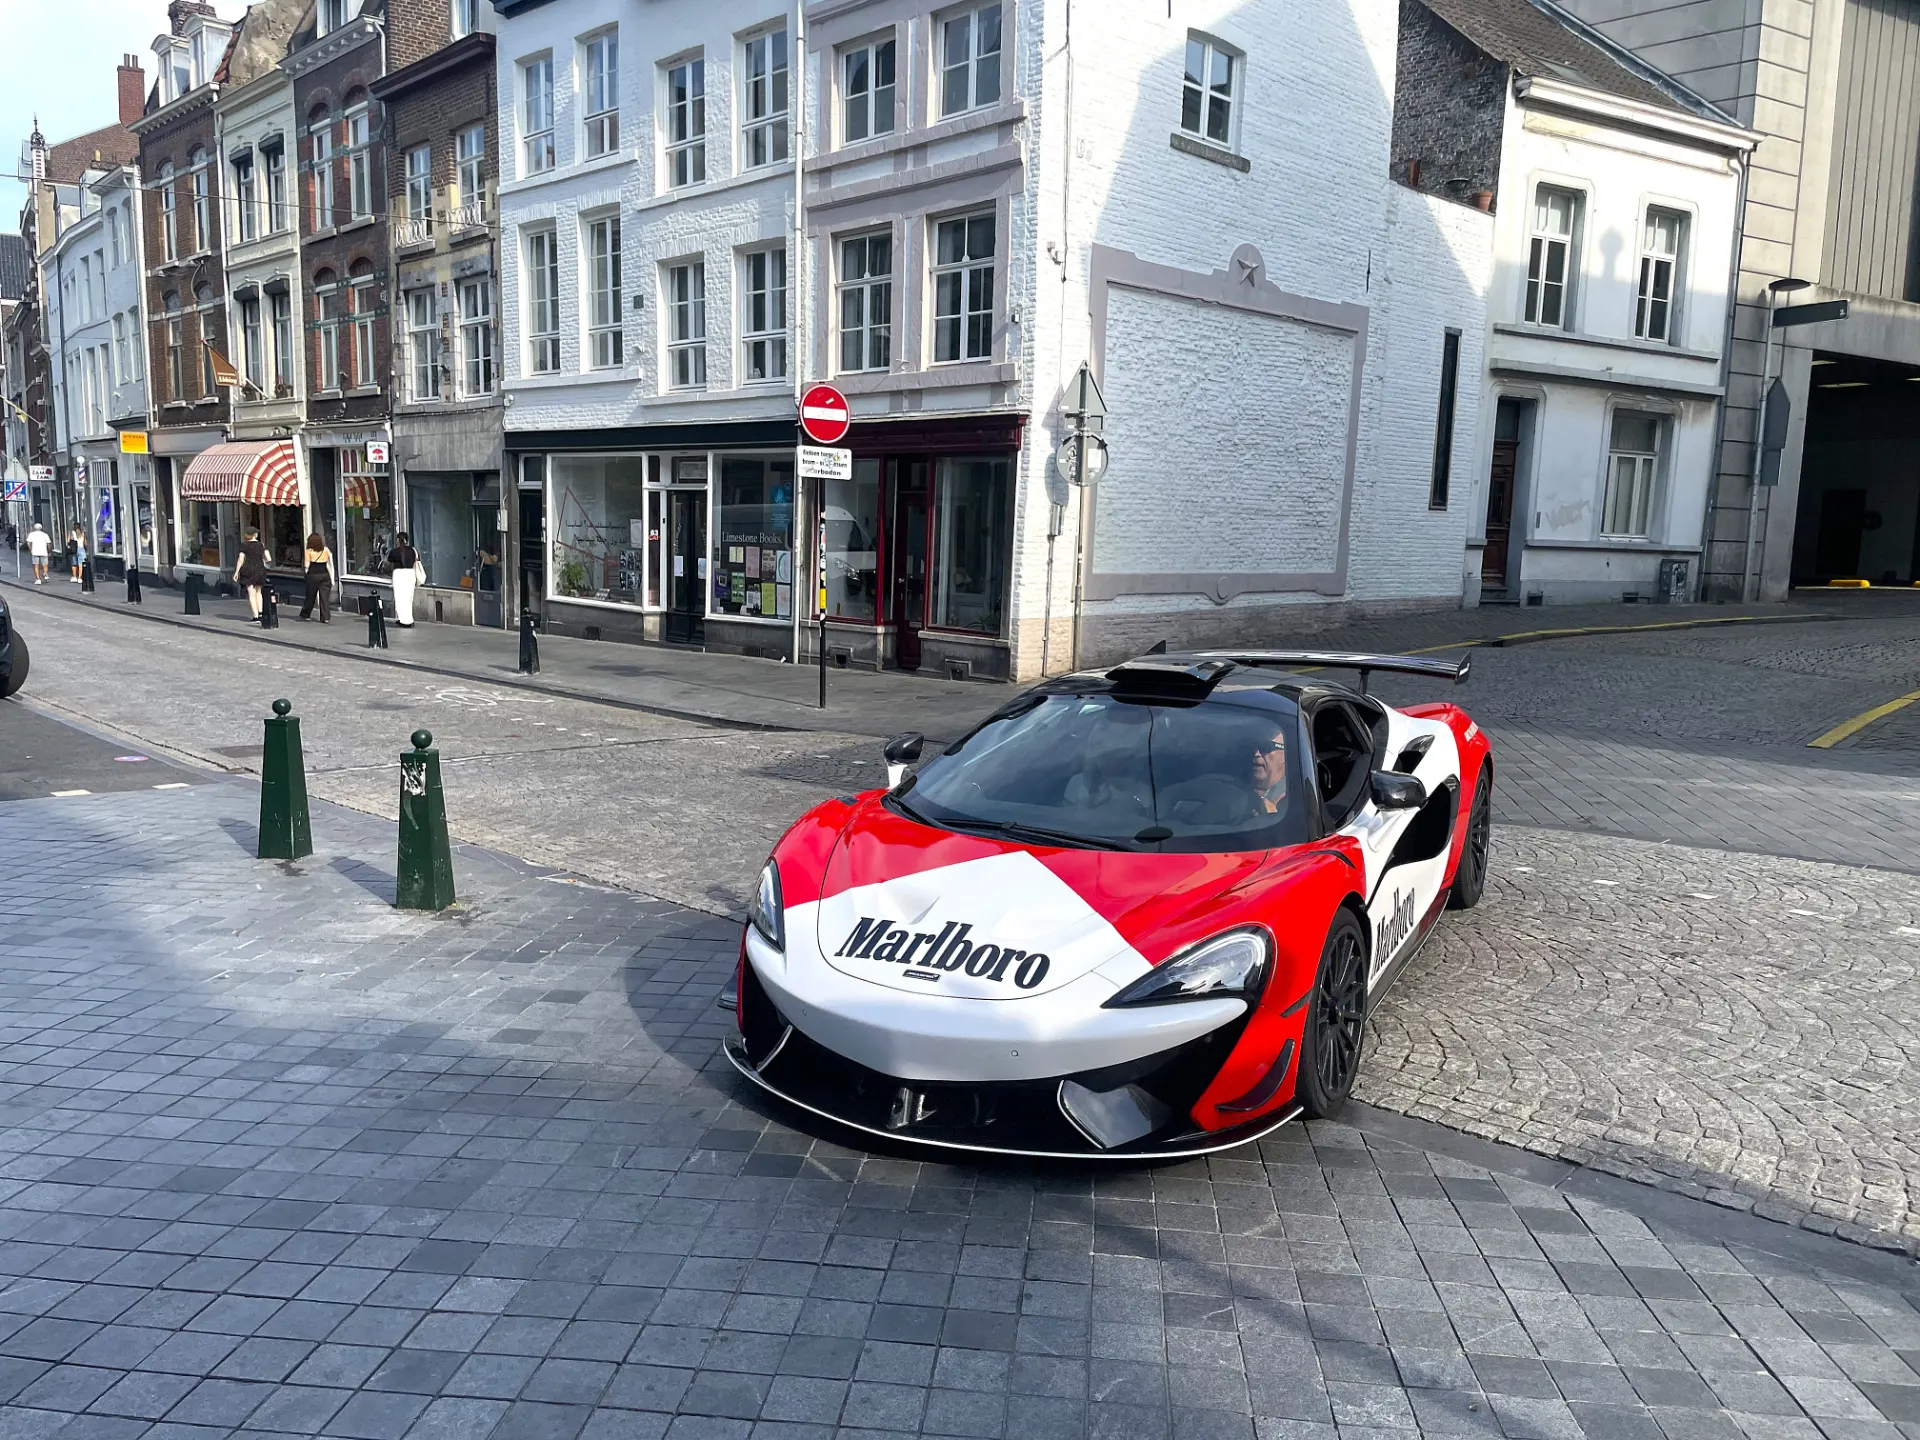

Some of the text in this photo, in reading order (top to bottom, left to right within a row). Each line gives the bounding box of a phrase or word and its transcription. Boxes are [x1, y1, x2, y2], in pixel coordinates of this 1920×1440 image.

[722, 531, 758, 543] Limestone
[834, 917, 1050, 989] Marlboro
[1371, 887, 1415, 981] Marlboro
